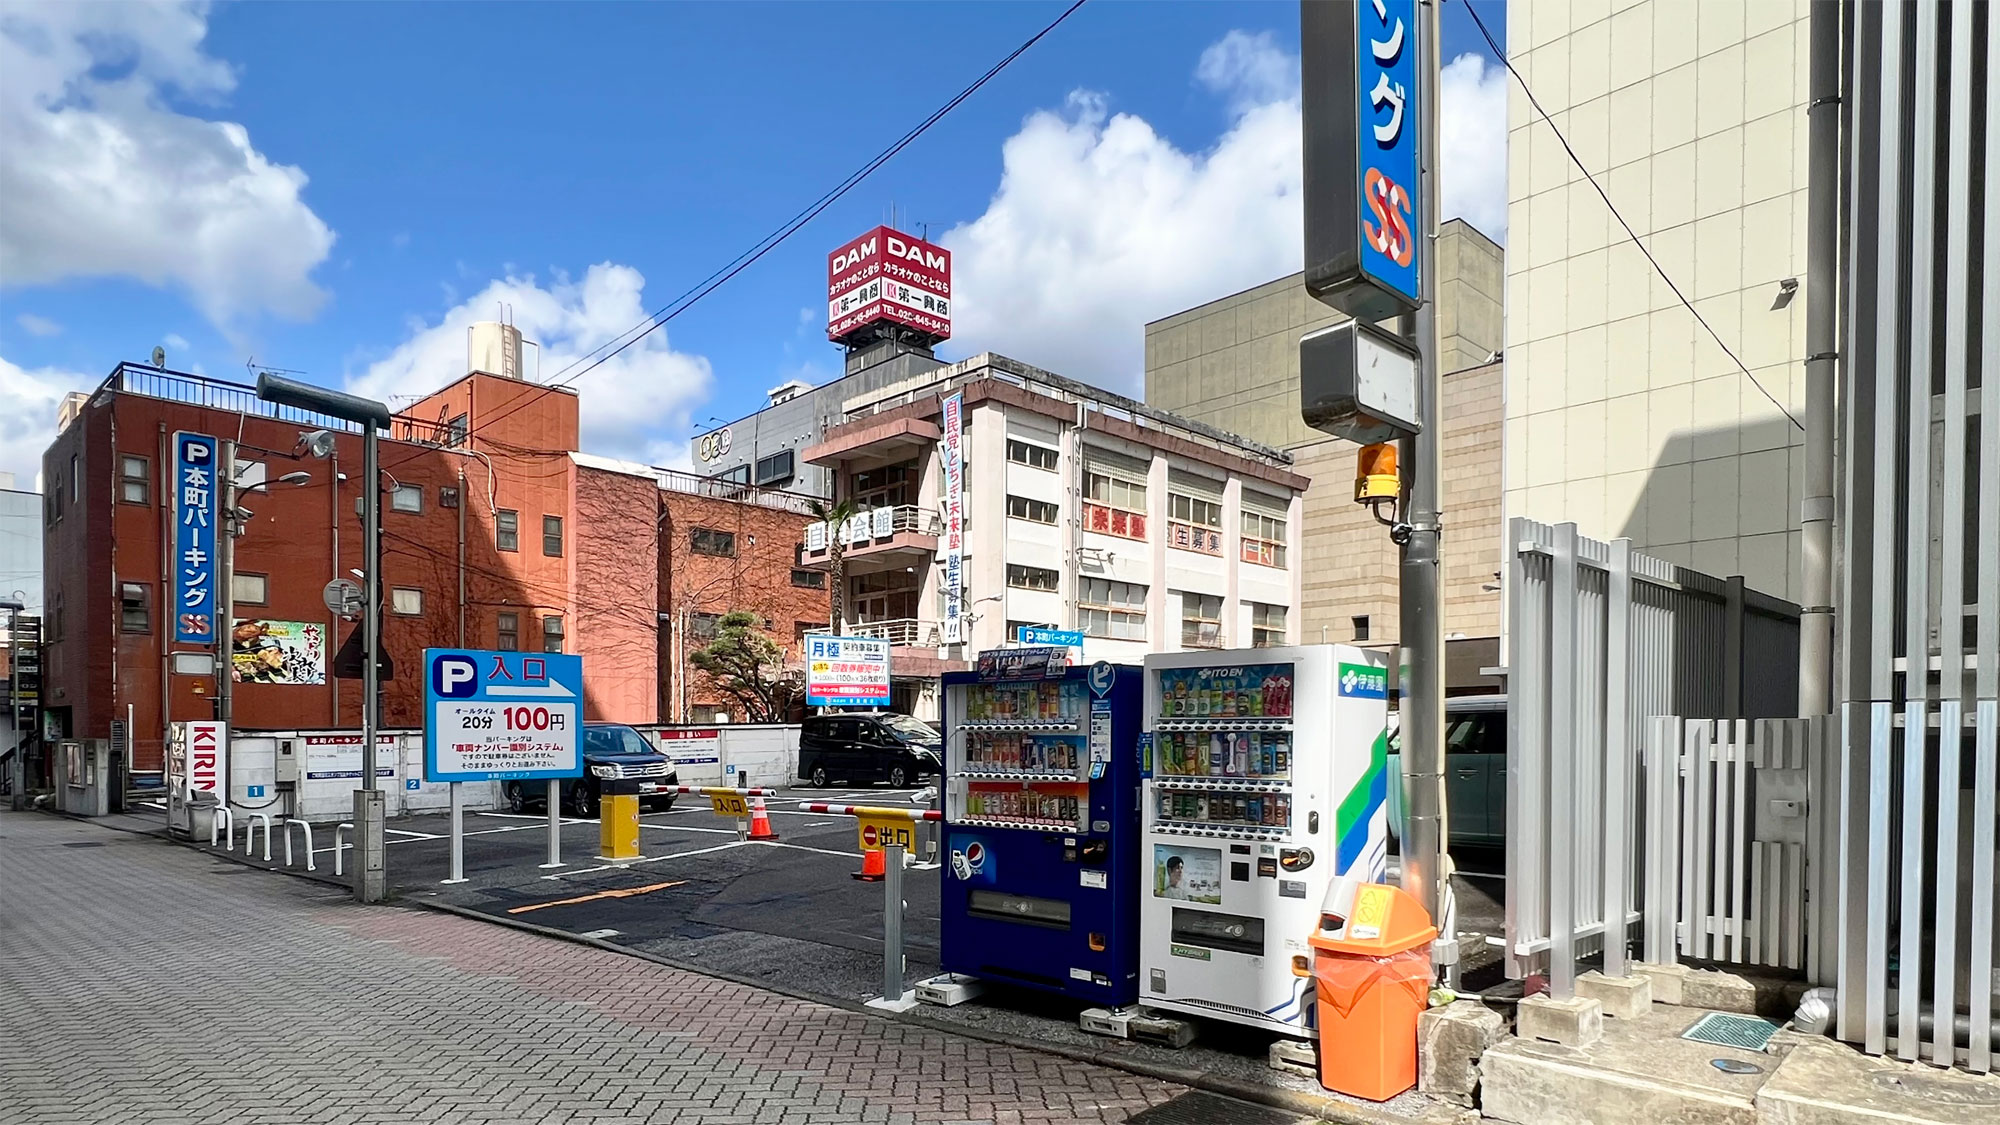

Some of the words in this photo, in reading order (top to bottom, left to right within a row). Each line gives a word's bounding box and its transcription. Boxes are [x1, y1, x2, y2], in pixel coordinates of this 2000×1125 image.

[832, 236, 877, 276] DAM
[887, 236, 946, 274] DAM
[829, 262, 880, 296] カラオケのことなら
[883, 261, 950, 294] カラオケのことなら
[840, 282, 879, 314] 第一興商
[898, 285, 948, 316] 第一興商
[187, 442, 209, 462] P
[946, 400, 961, 550] 自民党とちぎ未来塾
[183, 466, 209, 607] 本町パーキング
[810, 509, 891, 547] 自会館
[812, 641, 840, 658] 月極
[1026, 631, 1034, 642] P
[1035, 632, 1079, 644] 本町パーキング
[442, 660, 474, 693] P
[488, 656, 546, 681] 入口
[1092, 664, 1110, 688] ピ
[1211, 669, 1229, 677] ITO
[1229, 668, 1244, 677] EN
[1357, 673, 1384, 692] 伊藤園
[462, 716, 493, 730] 20分
[503, 706, 565, 731] 100円
[486, 735, 532, 743] 当パーキングは
[253, 786, 259, 796] 1
[409, 780, 417, 789] 2
[717, 797, 744, 813] 入口
[879, 827, 910, 849] 出口
